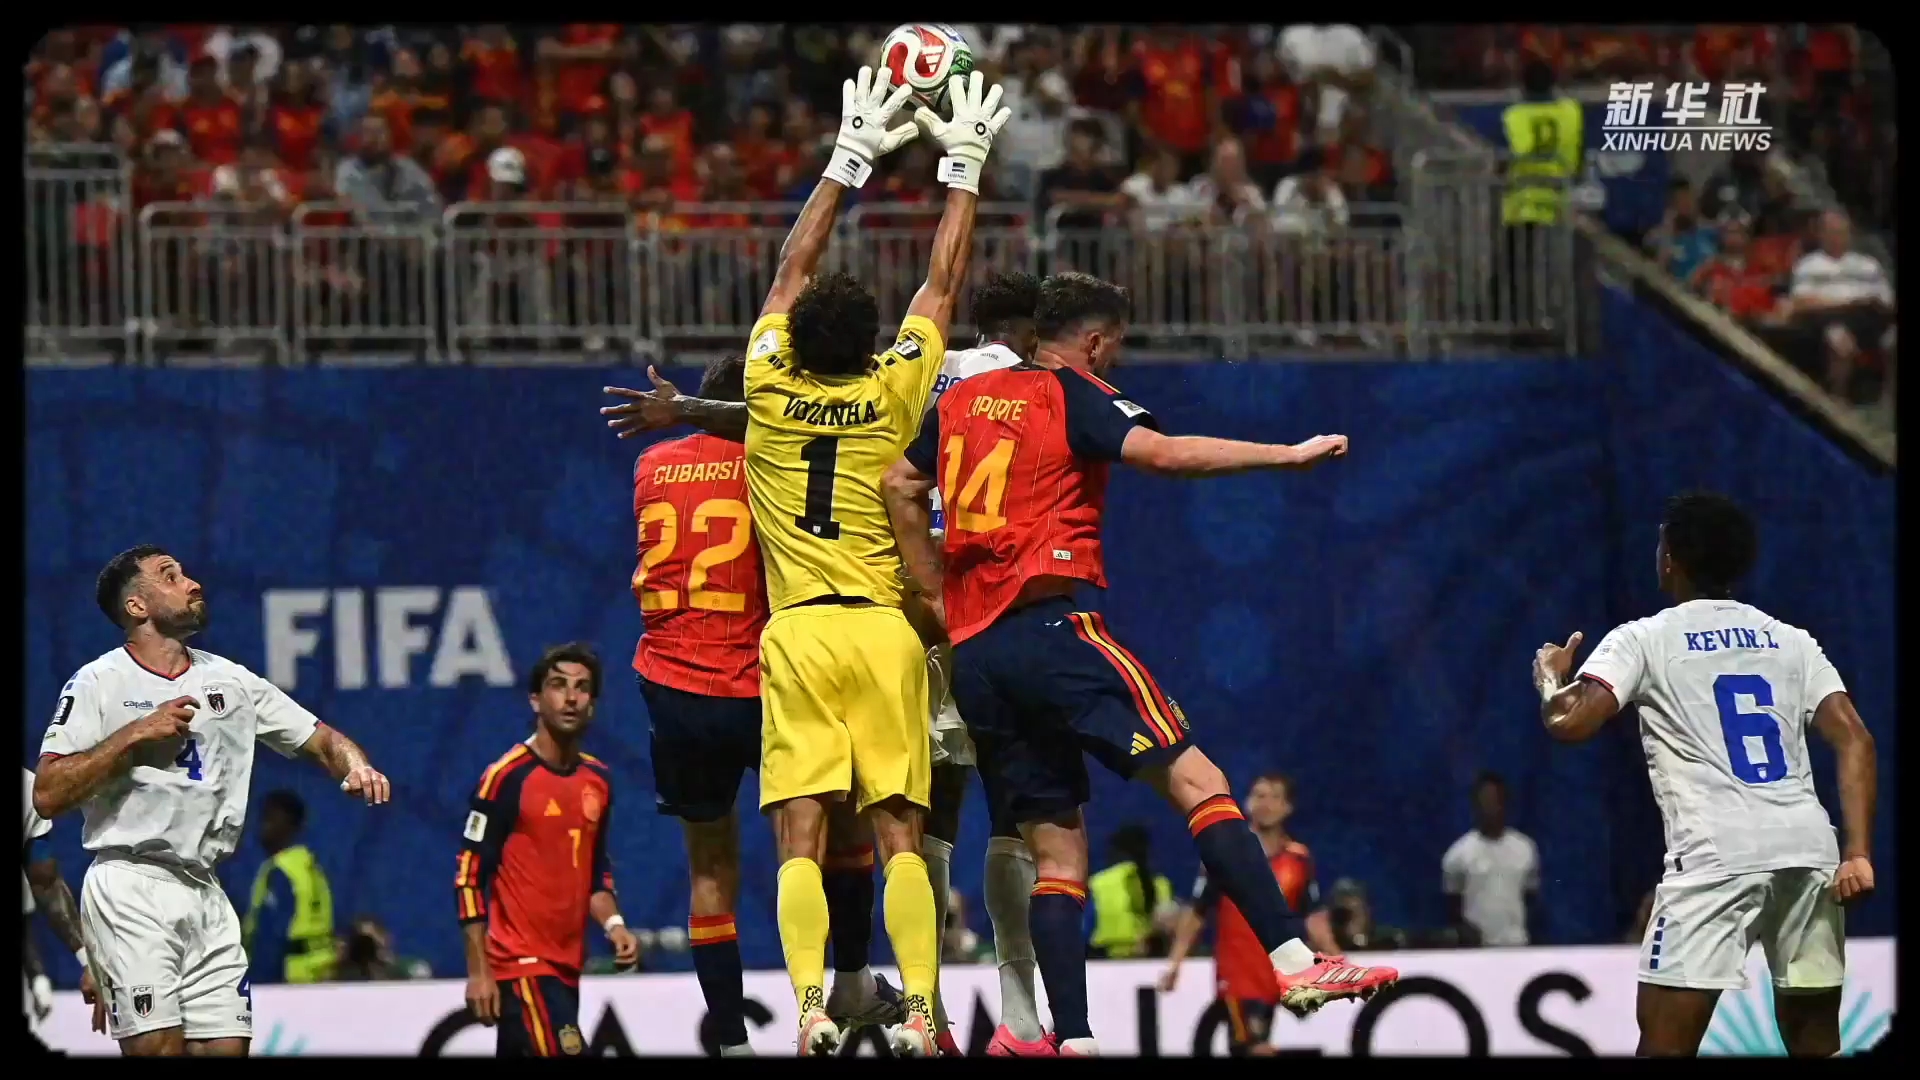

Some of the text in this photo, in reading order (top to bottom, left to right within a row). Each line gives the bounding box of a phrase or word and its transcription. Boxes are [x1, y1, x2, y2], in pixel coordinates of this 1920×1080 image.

[782, 395, 879, 427] VOZINHA
[653, 455, 743, 485] CUBARSÍ
[794, 436, 840, 541] 1
[943, 434, 1017, 534] 14
[632, 498, 751, 613] 22
[261, 585, 515, 689] FIFA
[175, 739, 203, 781] 4
[1712, 673, 1788, 784] 6
[567, 828, 581, 869] 7
